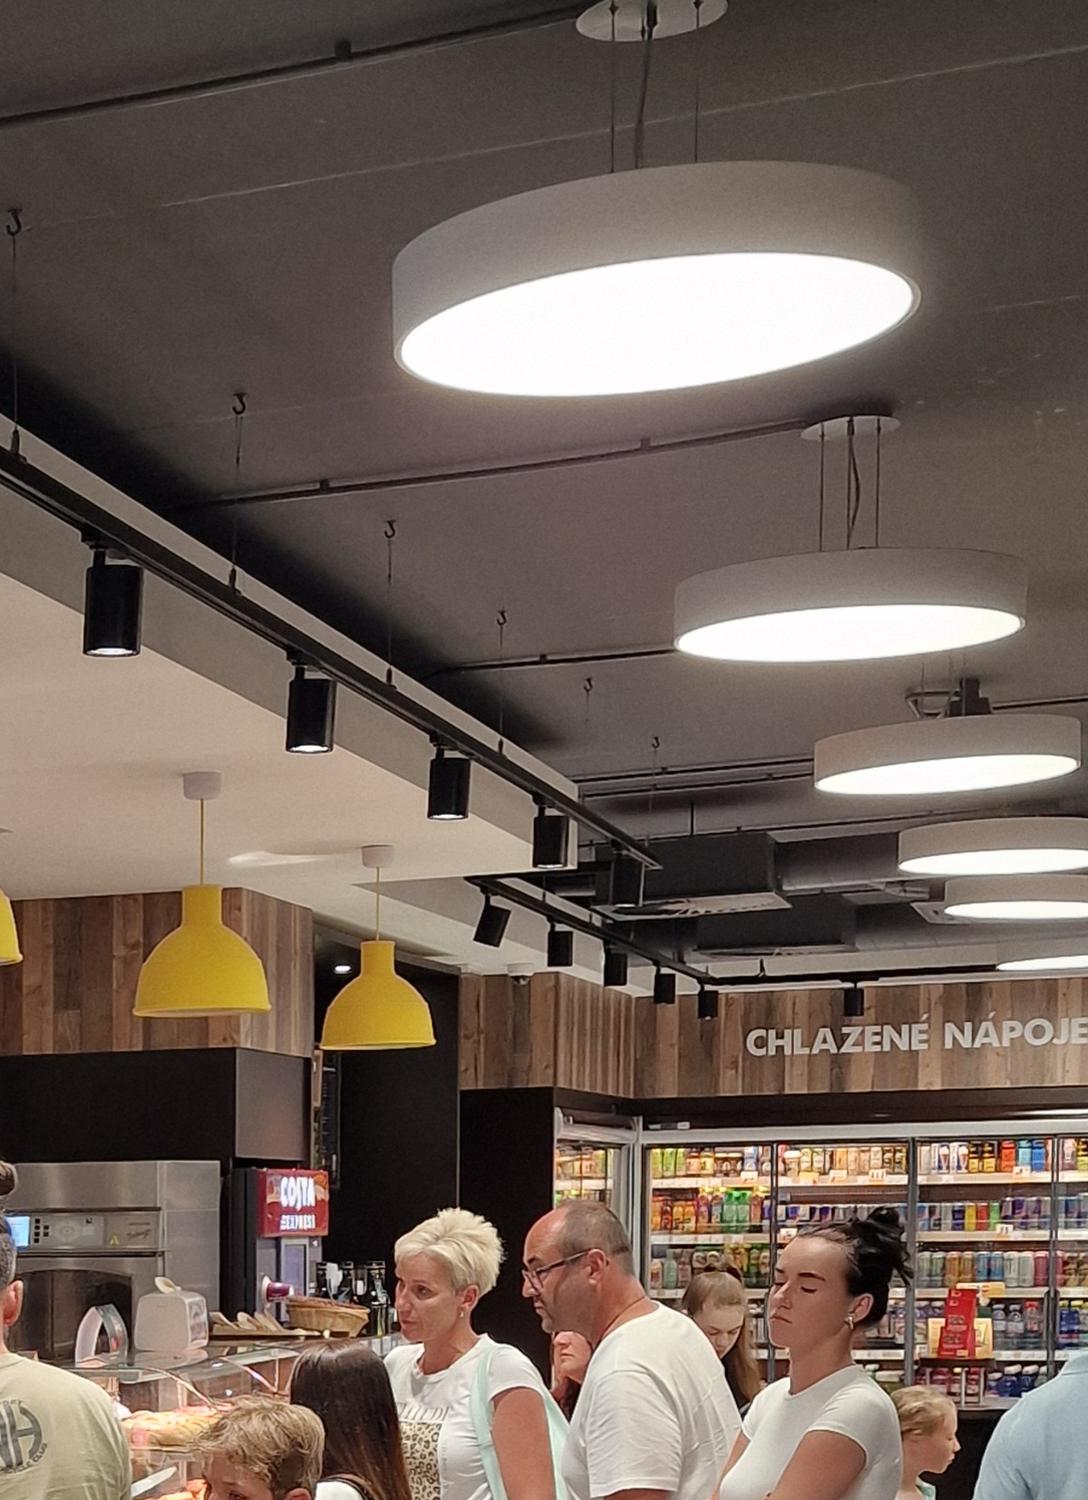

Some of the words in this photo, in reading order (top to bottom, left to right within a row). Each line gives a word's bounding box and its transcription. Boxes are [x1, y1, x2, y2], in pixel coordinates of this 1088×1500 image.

[746, 1013, 929, 1057] CHLAZENÉ
[944, 1011, 1088, 1049] NÁPOJE
[280, 1176, 316, 1211] COSTA
